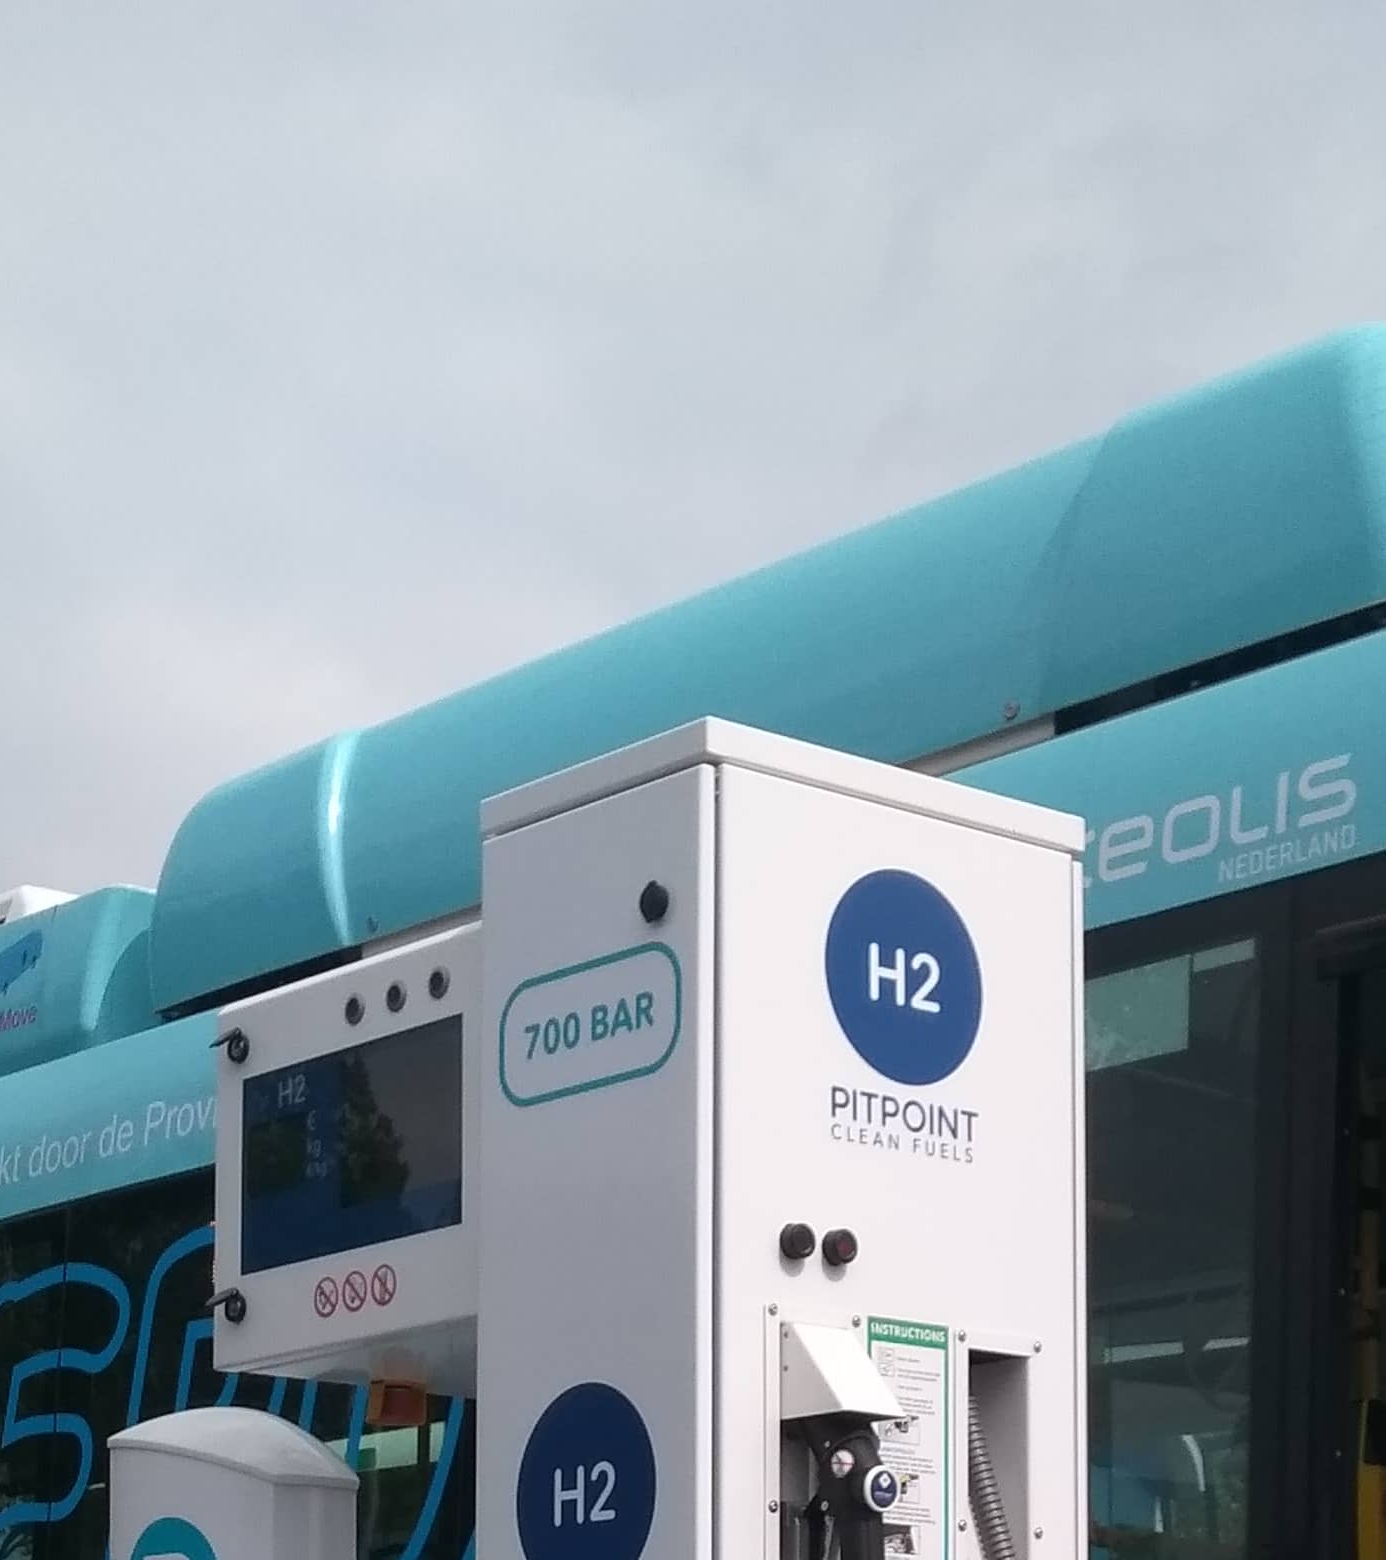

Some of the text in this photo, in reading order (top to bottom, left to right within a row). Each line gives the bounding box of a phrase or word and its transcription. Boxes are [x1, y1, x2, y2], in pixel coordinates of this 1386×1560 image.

[1218, 824, 1356, 883] NEDERLAND
[868, 942, 941, 1013] H2
[523, 991, 655, 1061] 700 BAR
[277, 1074, 306, 1109] H2
[830, 1085, 979, 1143] PITPOINT
[28, 1130, 93, 1179] door
[99, 1114, 134, 1159] de
[143, 1096, 217, 1147] Prov
[830, 1123, 974, 1164] CLEAN FUELS
[870, 1321, 946, 1343] INSTRUCTIONS
[553, 1460, 616, 1528] H2
